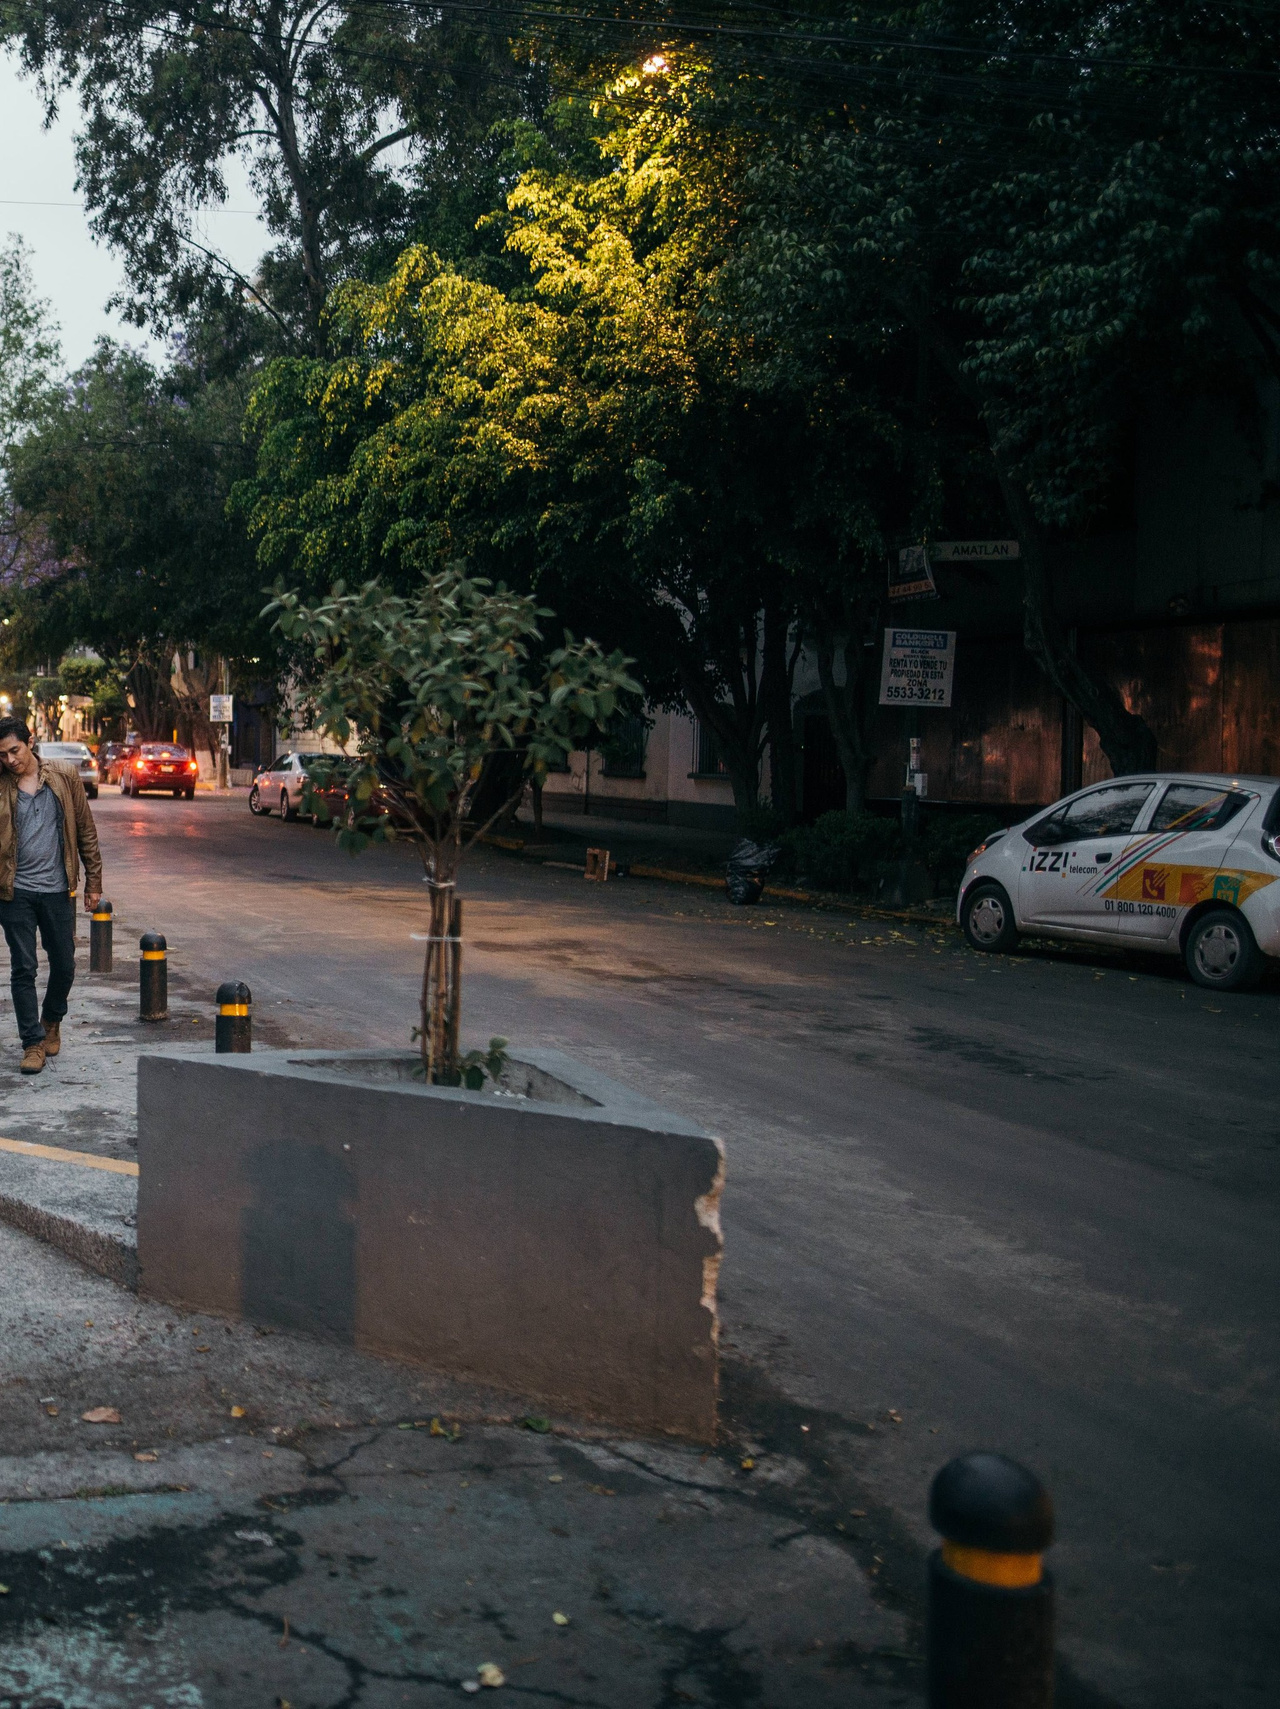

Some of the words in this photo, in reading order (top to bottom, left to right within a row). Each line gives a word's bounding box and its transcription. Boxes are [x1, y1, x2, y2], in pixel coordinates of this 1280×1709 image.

[952, 545, 1009, 556] AMATLAN
[889, 658, 908, 669] RENTA
[919, 660, 938, 671] VENDE
[939, 661, 948, 671] TU
[890, 668, 921, 679] PROPIEDAD
[921, 670, 930, 679] EN
[930, 671, 944, 680] ESTA
[906, 679, 928, 688] ZONA
[886, 686, 945, 700] 5533-3212
[1069, 865, 1098, 875] telecom
[1104, 900, 1115, 911] 01
[1117, 902, 1135, 914] 800
[1137, 904, 1154, 915] 120
[1155, 906, 1177, 919] 4000
